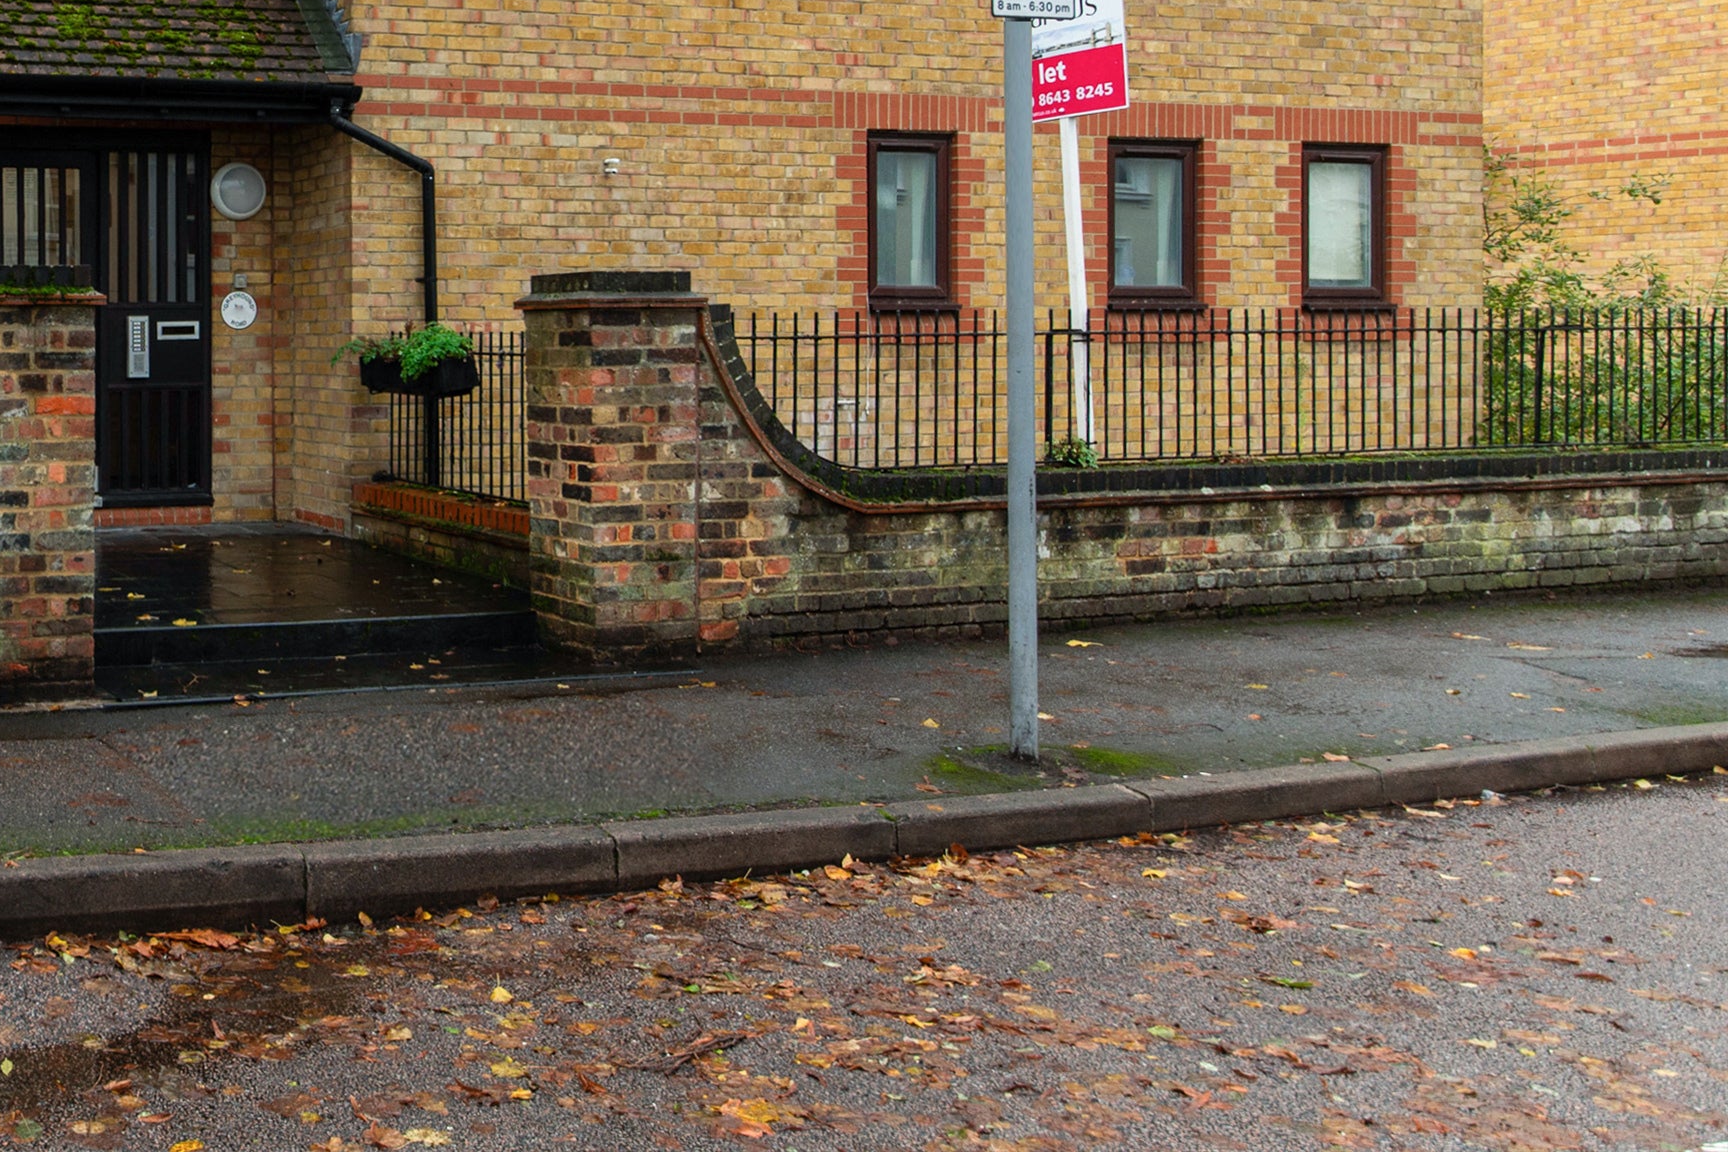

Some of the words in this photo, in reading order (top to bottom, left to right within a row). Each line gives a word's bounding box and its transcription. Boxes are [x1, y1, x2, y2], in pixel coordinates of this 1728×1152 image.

[997, 0, 1004, 10] 8
[1006, 2, 1021, 11] am
[1029, 1, 1053, 12] 6:30
[1055, 5, 1070, 14] pm
[1038, 60, 1067, 85] let
[1038, 89, 1071, 107] 8643
[1075, 82, 1114, 100] 8245
